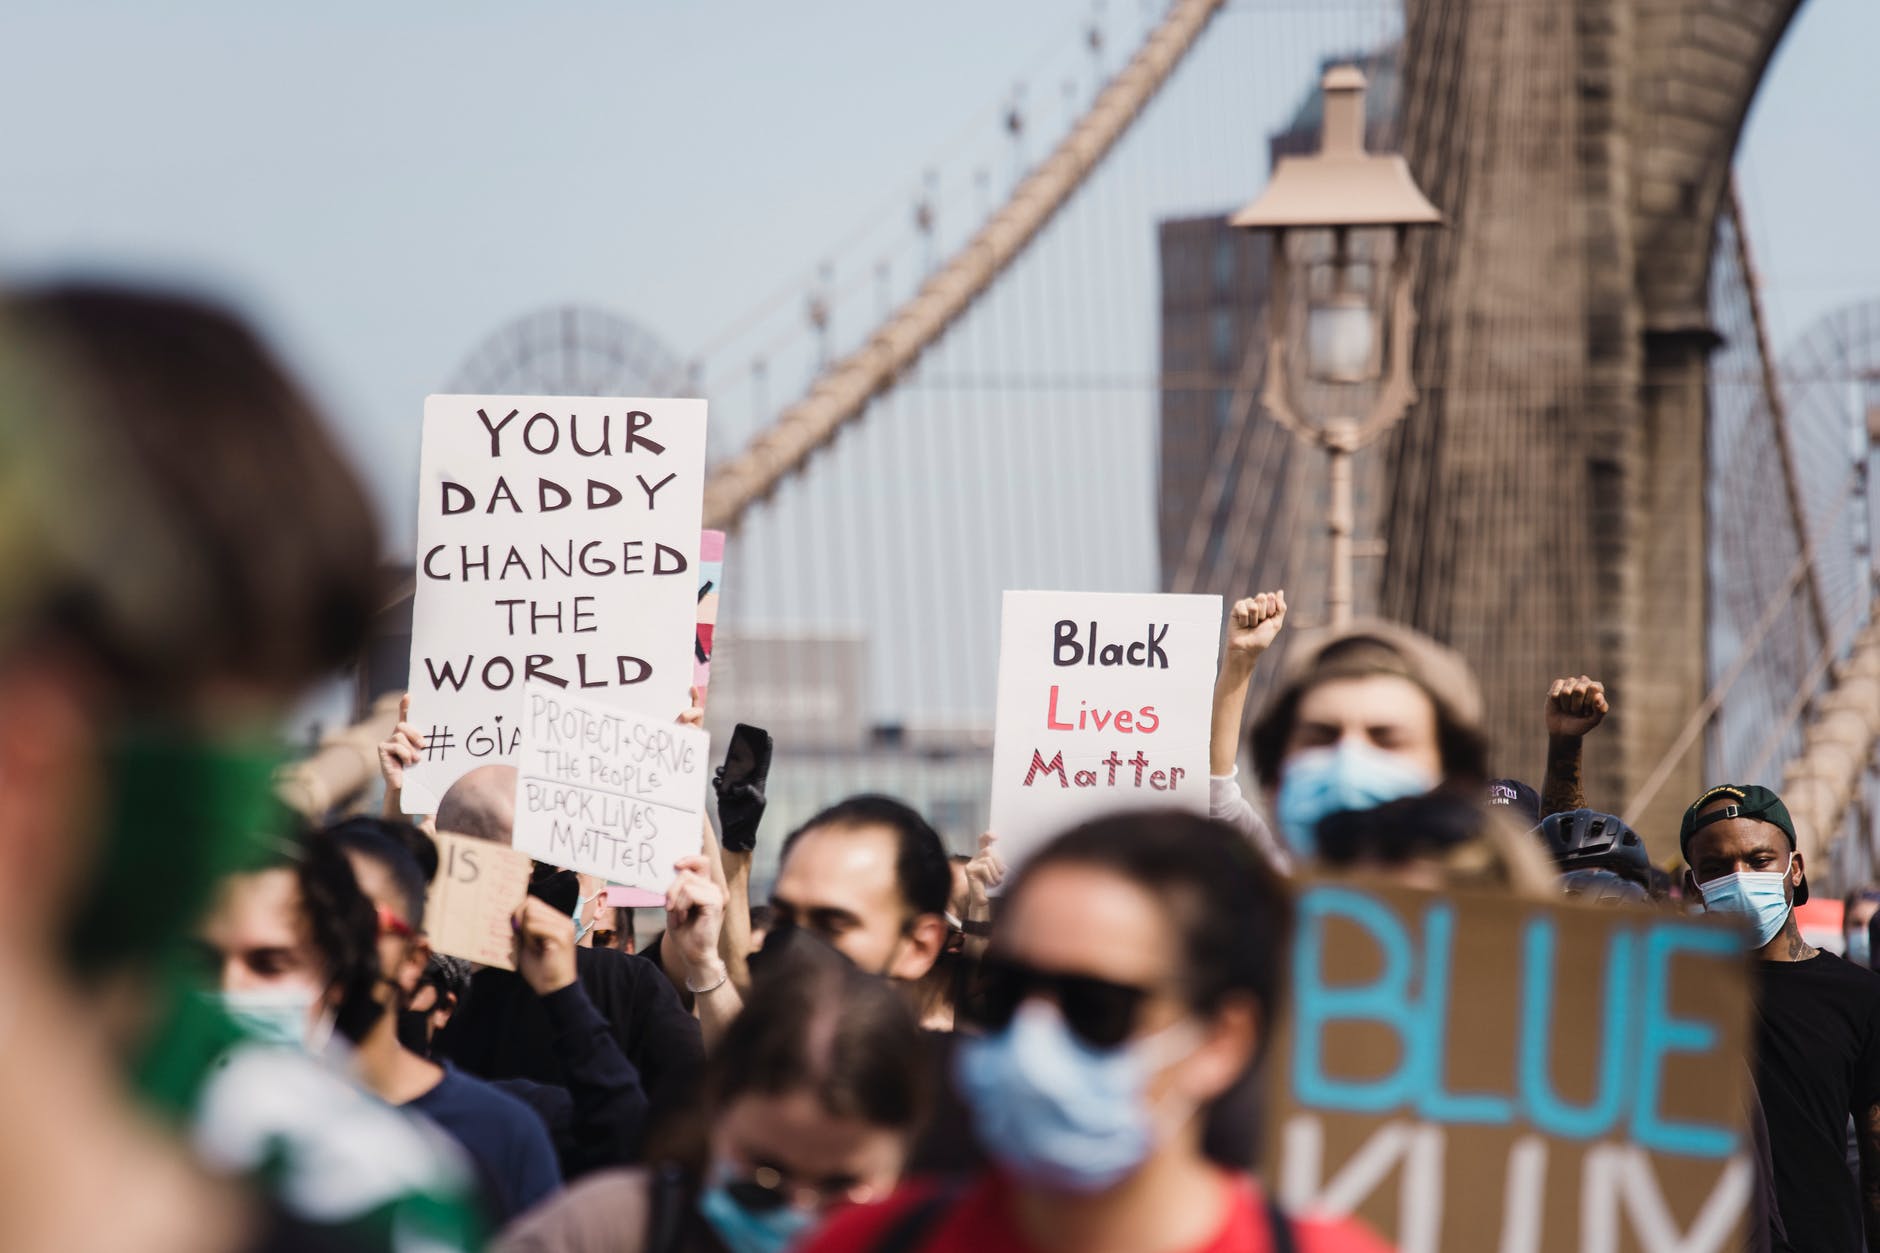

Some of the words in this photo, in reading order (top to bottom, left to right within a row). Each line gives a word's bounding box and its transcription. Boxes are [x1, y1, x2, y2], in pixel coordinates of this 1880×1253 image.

[477, 409, 666, 457] YOUR
[441, 473, 677, 516] DADDY
[423, 539, 688, 582] CHANGED
[495, 596, 598, 636] THE
[424, 653, 653, 692] WORLD
[1047, 685, 1160, 733] Lives
[537, 748, 581, 781] THE
[589, 755, 663, 794] PEOPLE
[1022, 748, 1185, 790] Matter
[526, 783, 595, 824] BLACK
[448, 844, 480, 884] IS
[550, 820, 658, 878] MATTER
[1291, 885, 1745, 1158] BLUE
